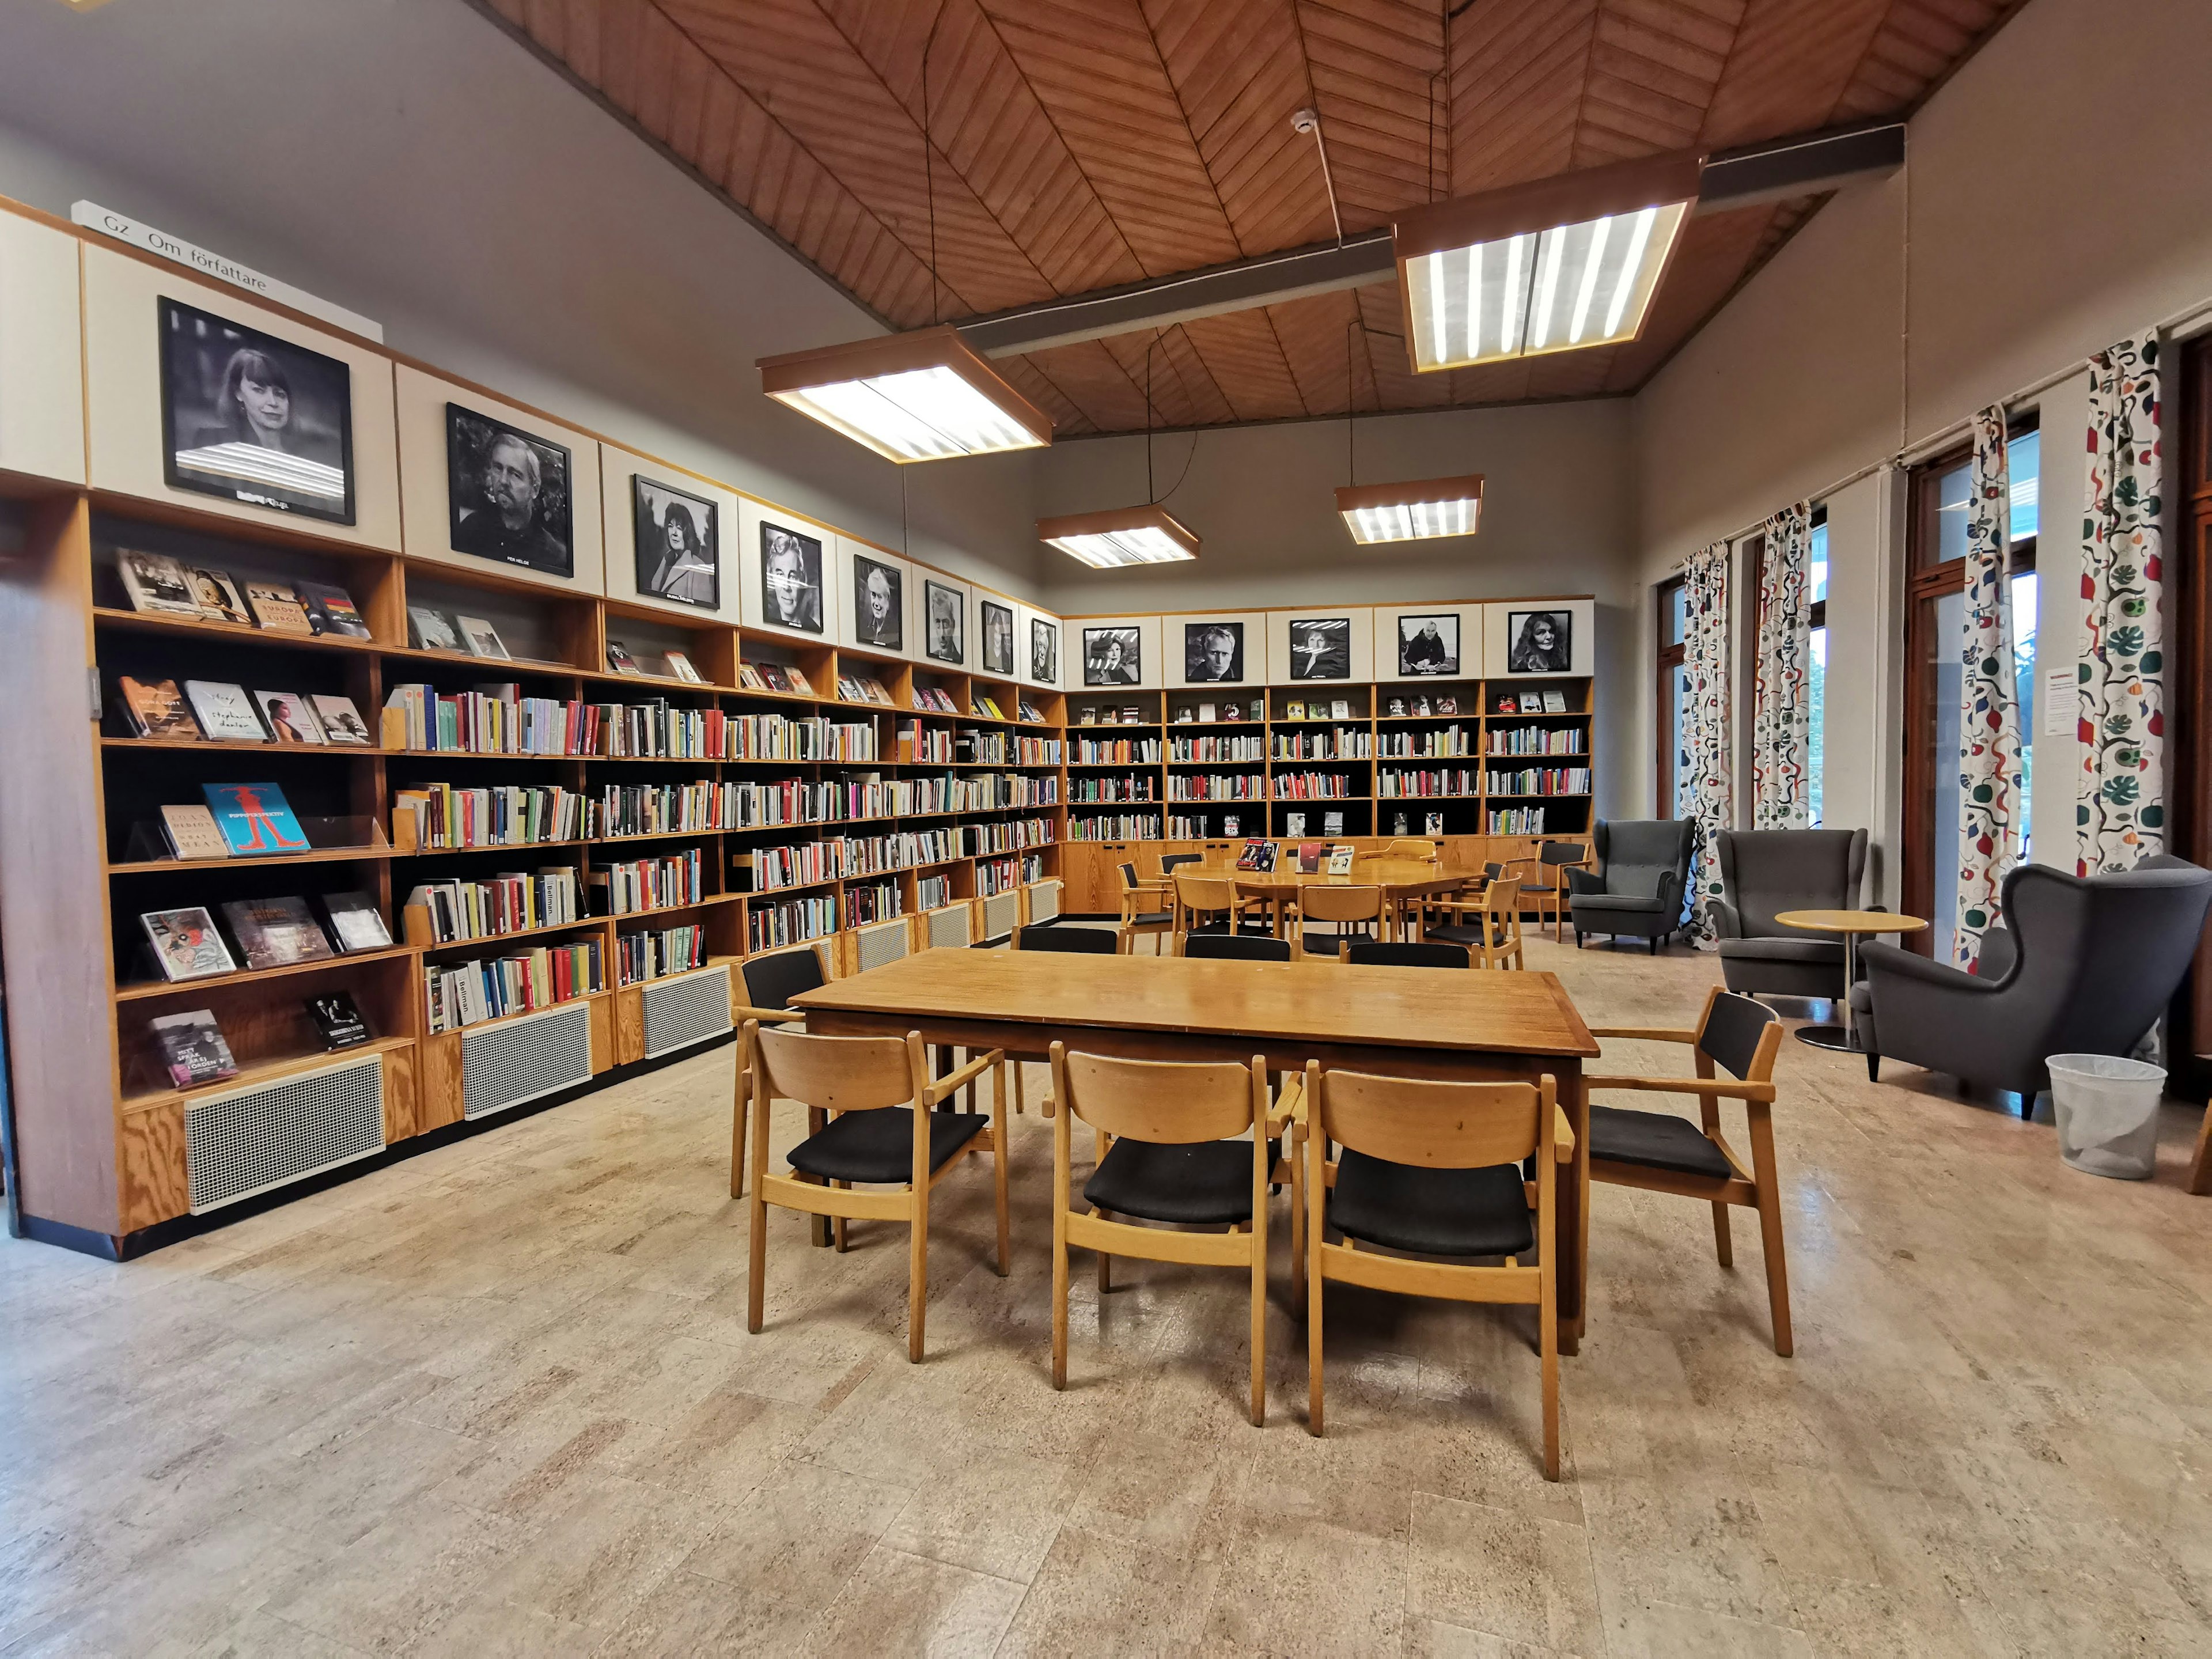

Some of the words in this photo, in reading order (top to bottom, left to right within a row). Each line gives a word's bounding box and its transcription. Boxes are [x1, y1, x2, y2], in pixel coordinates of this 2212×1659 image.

[104, 216, 129, 236] Gz
[149, 233, 180, 256] Om
[192, 249, 266, 291] författare
[1225, 827, 1238, 836] BECK
[181, 841, 220, 849] MEAN
